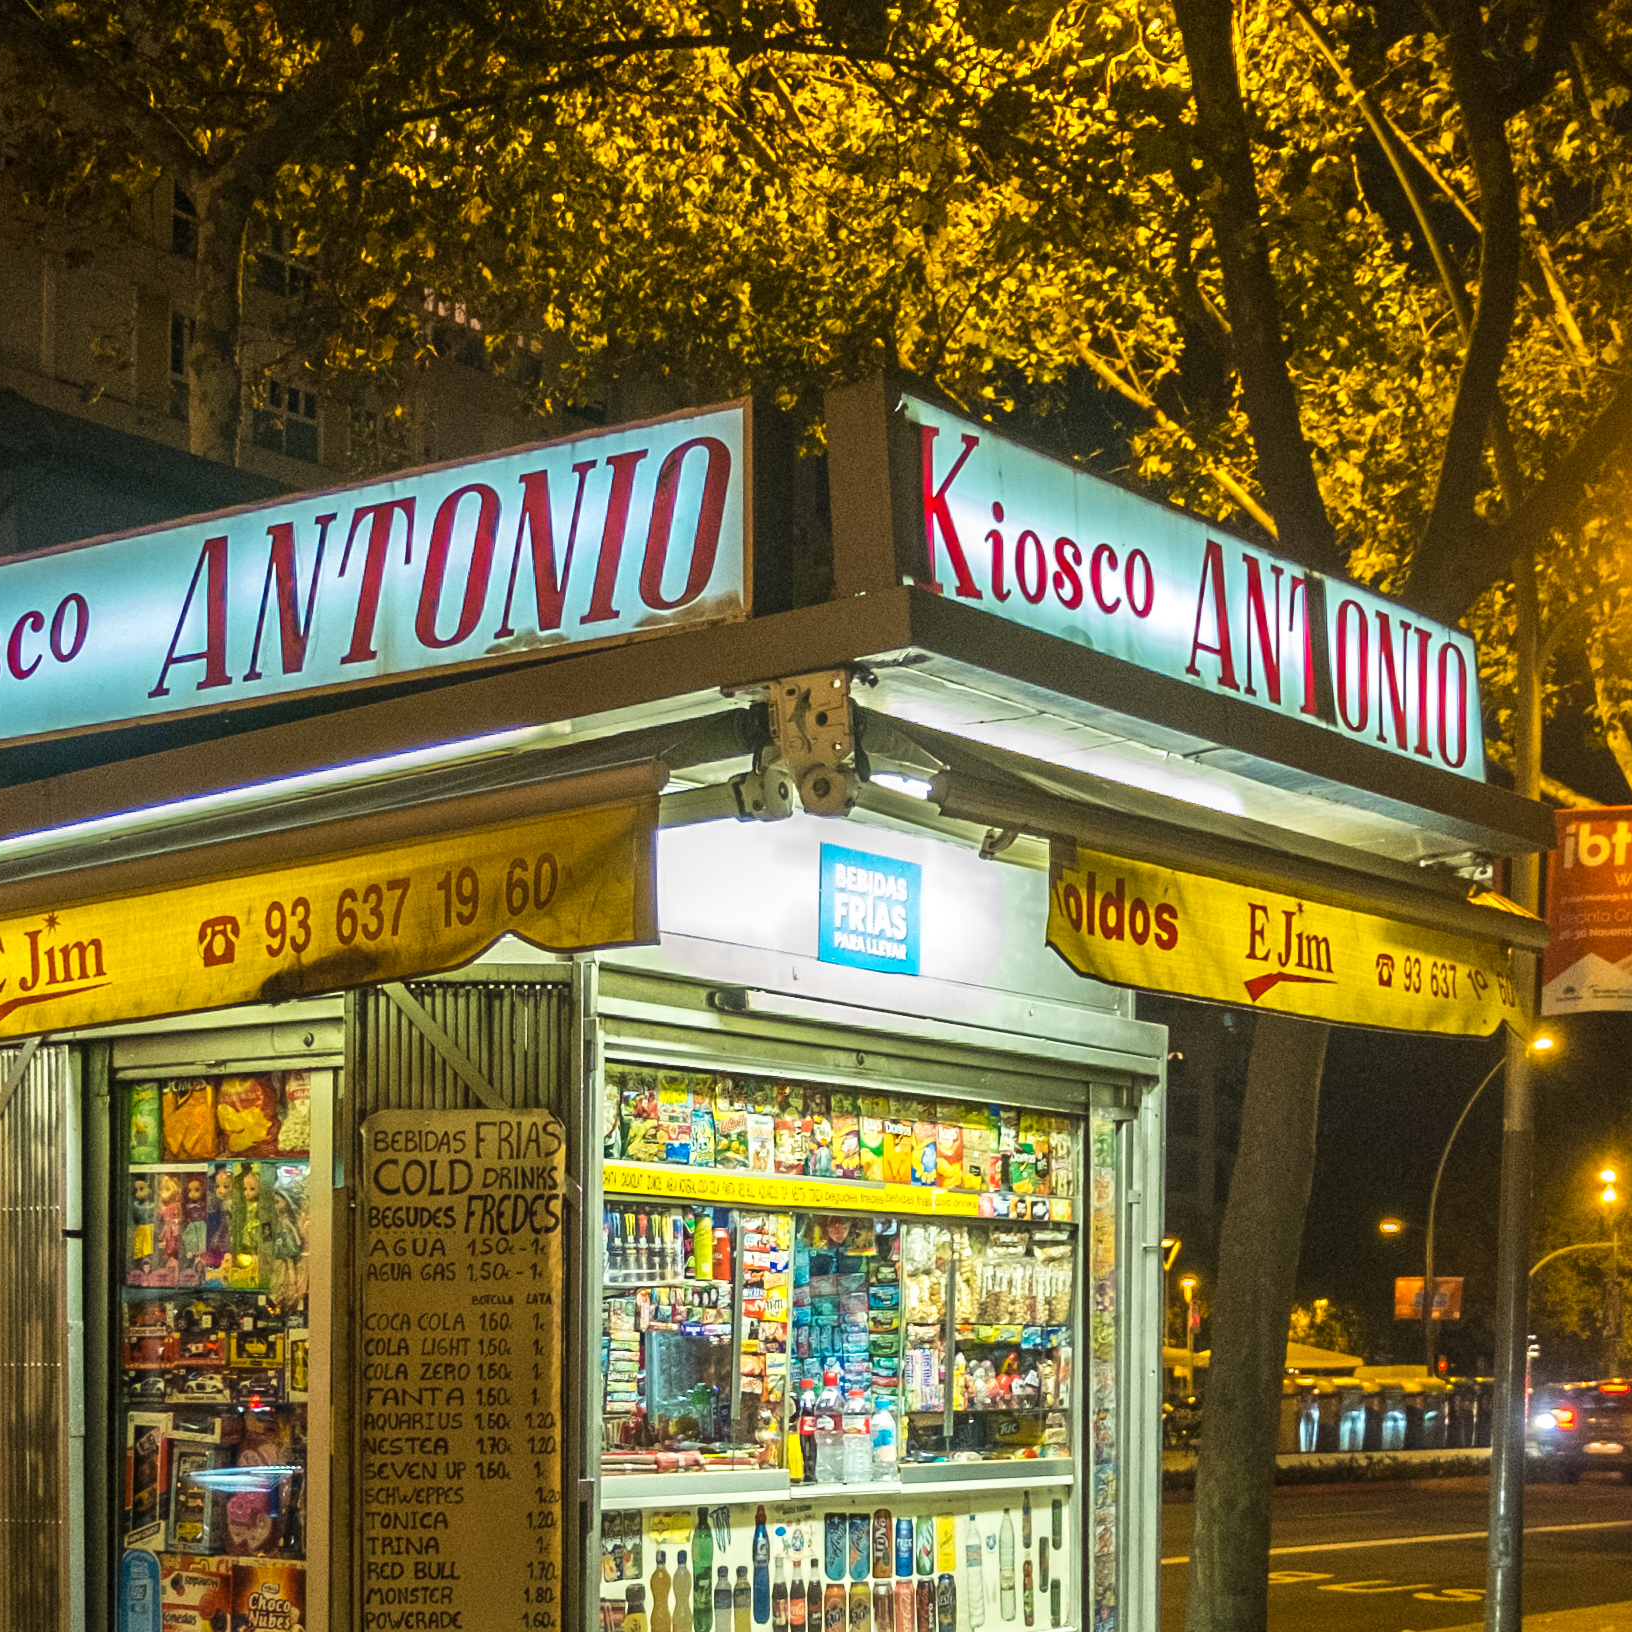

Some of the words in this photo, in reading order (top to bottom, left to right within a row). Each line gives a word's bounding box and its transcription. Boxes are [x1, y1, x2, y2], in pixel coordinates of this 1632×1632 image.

[148, 435, 732, 698] ANTONIO
[919, 425, 1155, 620] Kiosco
[1185, 540, 1467, 770] ANTONIO
[835, 863, 908, 902] BEBIDAS
[265, 899, 313, 955] 93
[336, 879, 409, 948] 637
[438, 867, 480, 926] 19
[505, 853, 558, 917] 60
[834, 931, 865, 952] PARA
[867, 937, 907, 960] LLEVAR
[1404, 955, 1422, 994] 93
[1430, 961, 1457, 999] 637
[373, 1129, 467, 1154] BEBIDAS
[475, 1119, 562, 1159] FRIAS
[372, 1158, 473, 1196] COLD
[480, 1165, 559, 1191] DRINKS
[368, 1205, 457, 1230] BEGUDES
[464, 1192, 561, 1236] FREDES
[369, 1237, 447, 1258] AGUA
[367, 1262, 412, 1282] AGUA
[420, 1262, 456, 1282] GAS
[526, 1293, 553, 1305] LATA
[365, 1312, 411, 1333] COCA
[417, 1312, 466, 1332] COLA
[364, 1337, 410, 1357] COLA
[420, 1337, 471, 1357] LIGHT
[364, 1362, 409, 1382] COLA
[419, 1362, 471, 1382] ZERO
[365, 1386, 465, 1407] FANTA
[364, 1412, 463, 1431] AQUARIUS
[364, 1437, 449, 1455] NESTEA
[364, 1462, 438, 1480] SEVEN
[446, 1462, 467, 1480] UP
[364, 1487, 464, 1505] SCHWEPPES
[365, 1511, 449, 1531] TONICA
[366, 1536, 440, 1556] TRINA
[367, 1561, 405, 1581] RED
[414, 1561, 461, 1580] BULL
[248, 1592, 292, 1612] Choco
[365, 1586, 454, 1605] MONSTER
[248, 1610, 291, 1630] Nubes
[365, 1611, 463, 1630] POWERADE
